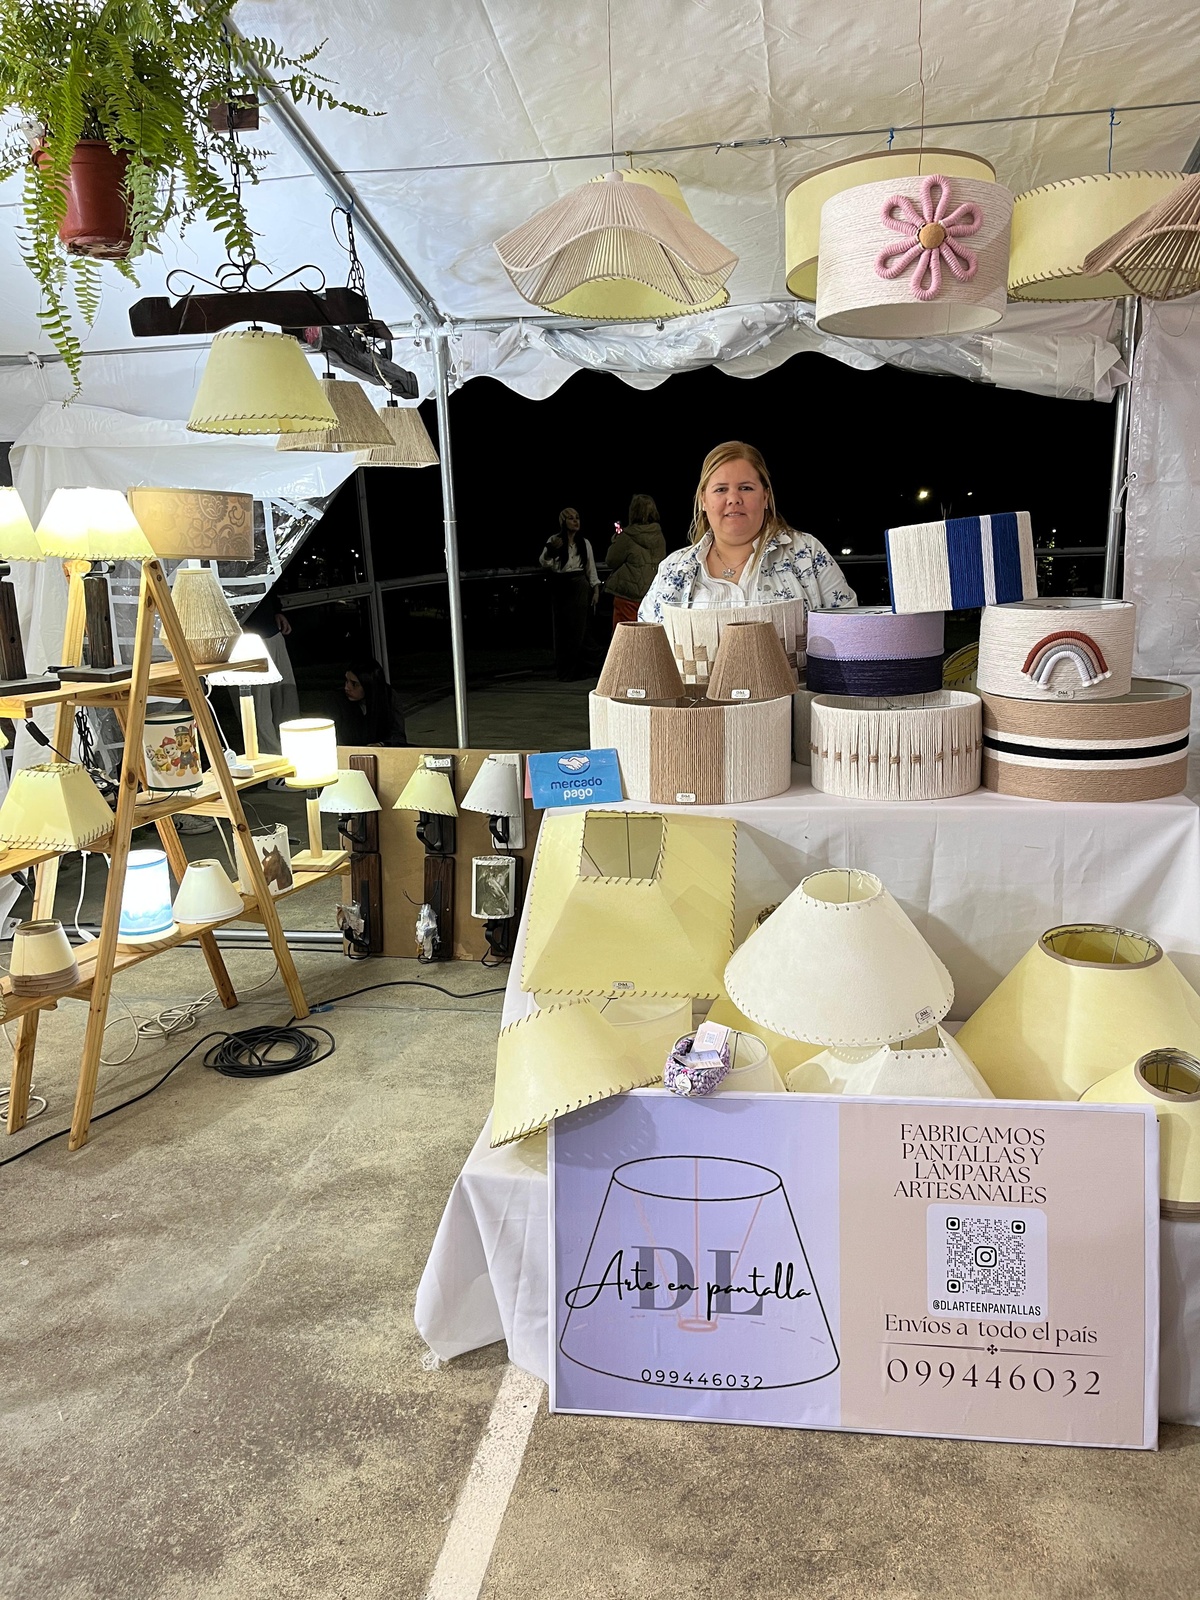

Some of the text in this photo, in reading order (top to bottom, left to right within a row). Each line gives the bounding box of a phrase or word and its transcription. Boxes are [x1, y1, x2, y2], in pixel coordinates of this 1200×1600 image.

[551, 777, 603, 790] mercado
[563, 788, 593, 801] pago
[900, 1123, 1046, 1146] FABRICAMOS
[902, 1142, 1044, 1165] PANTALLAS Y
[915, 1159, 1031, 1184] LÁMPARAS
[893, 1180, 1048, 1205] ARTESANALES
[565, 1249, 812, 1321] Arte en pantalla
[932, 1299, 1042, 1317] @DLARTEENPANTALLAS
[885, 1313, 1098, 1347] Envíos a todo el país
[641, 1368, 763, 1389] 099446032
[886, 1358, 1101, 1398] 099446032
